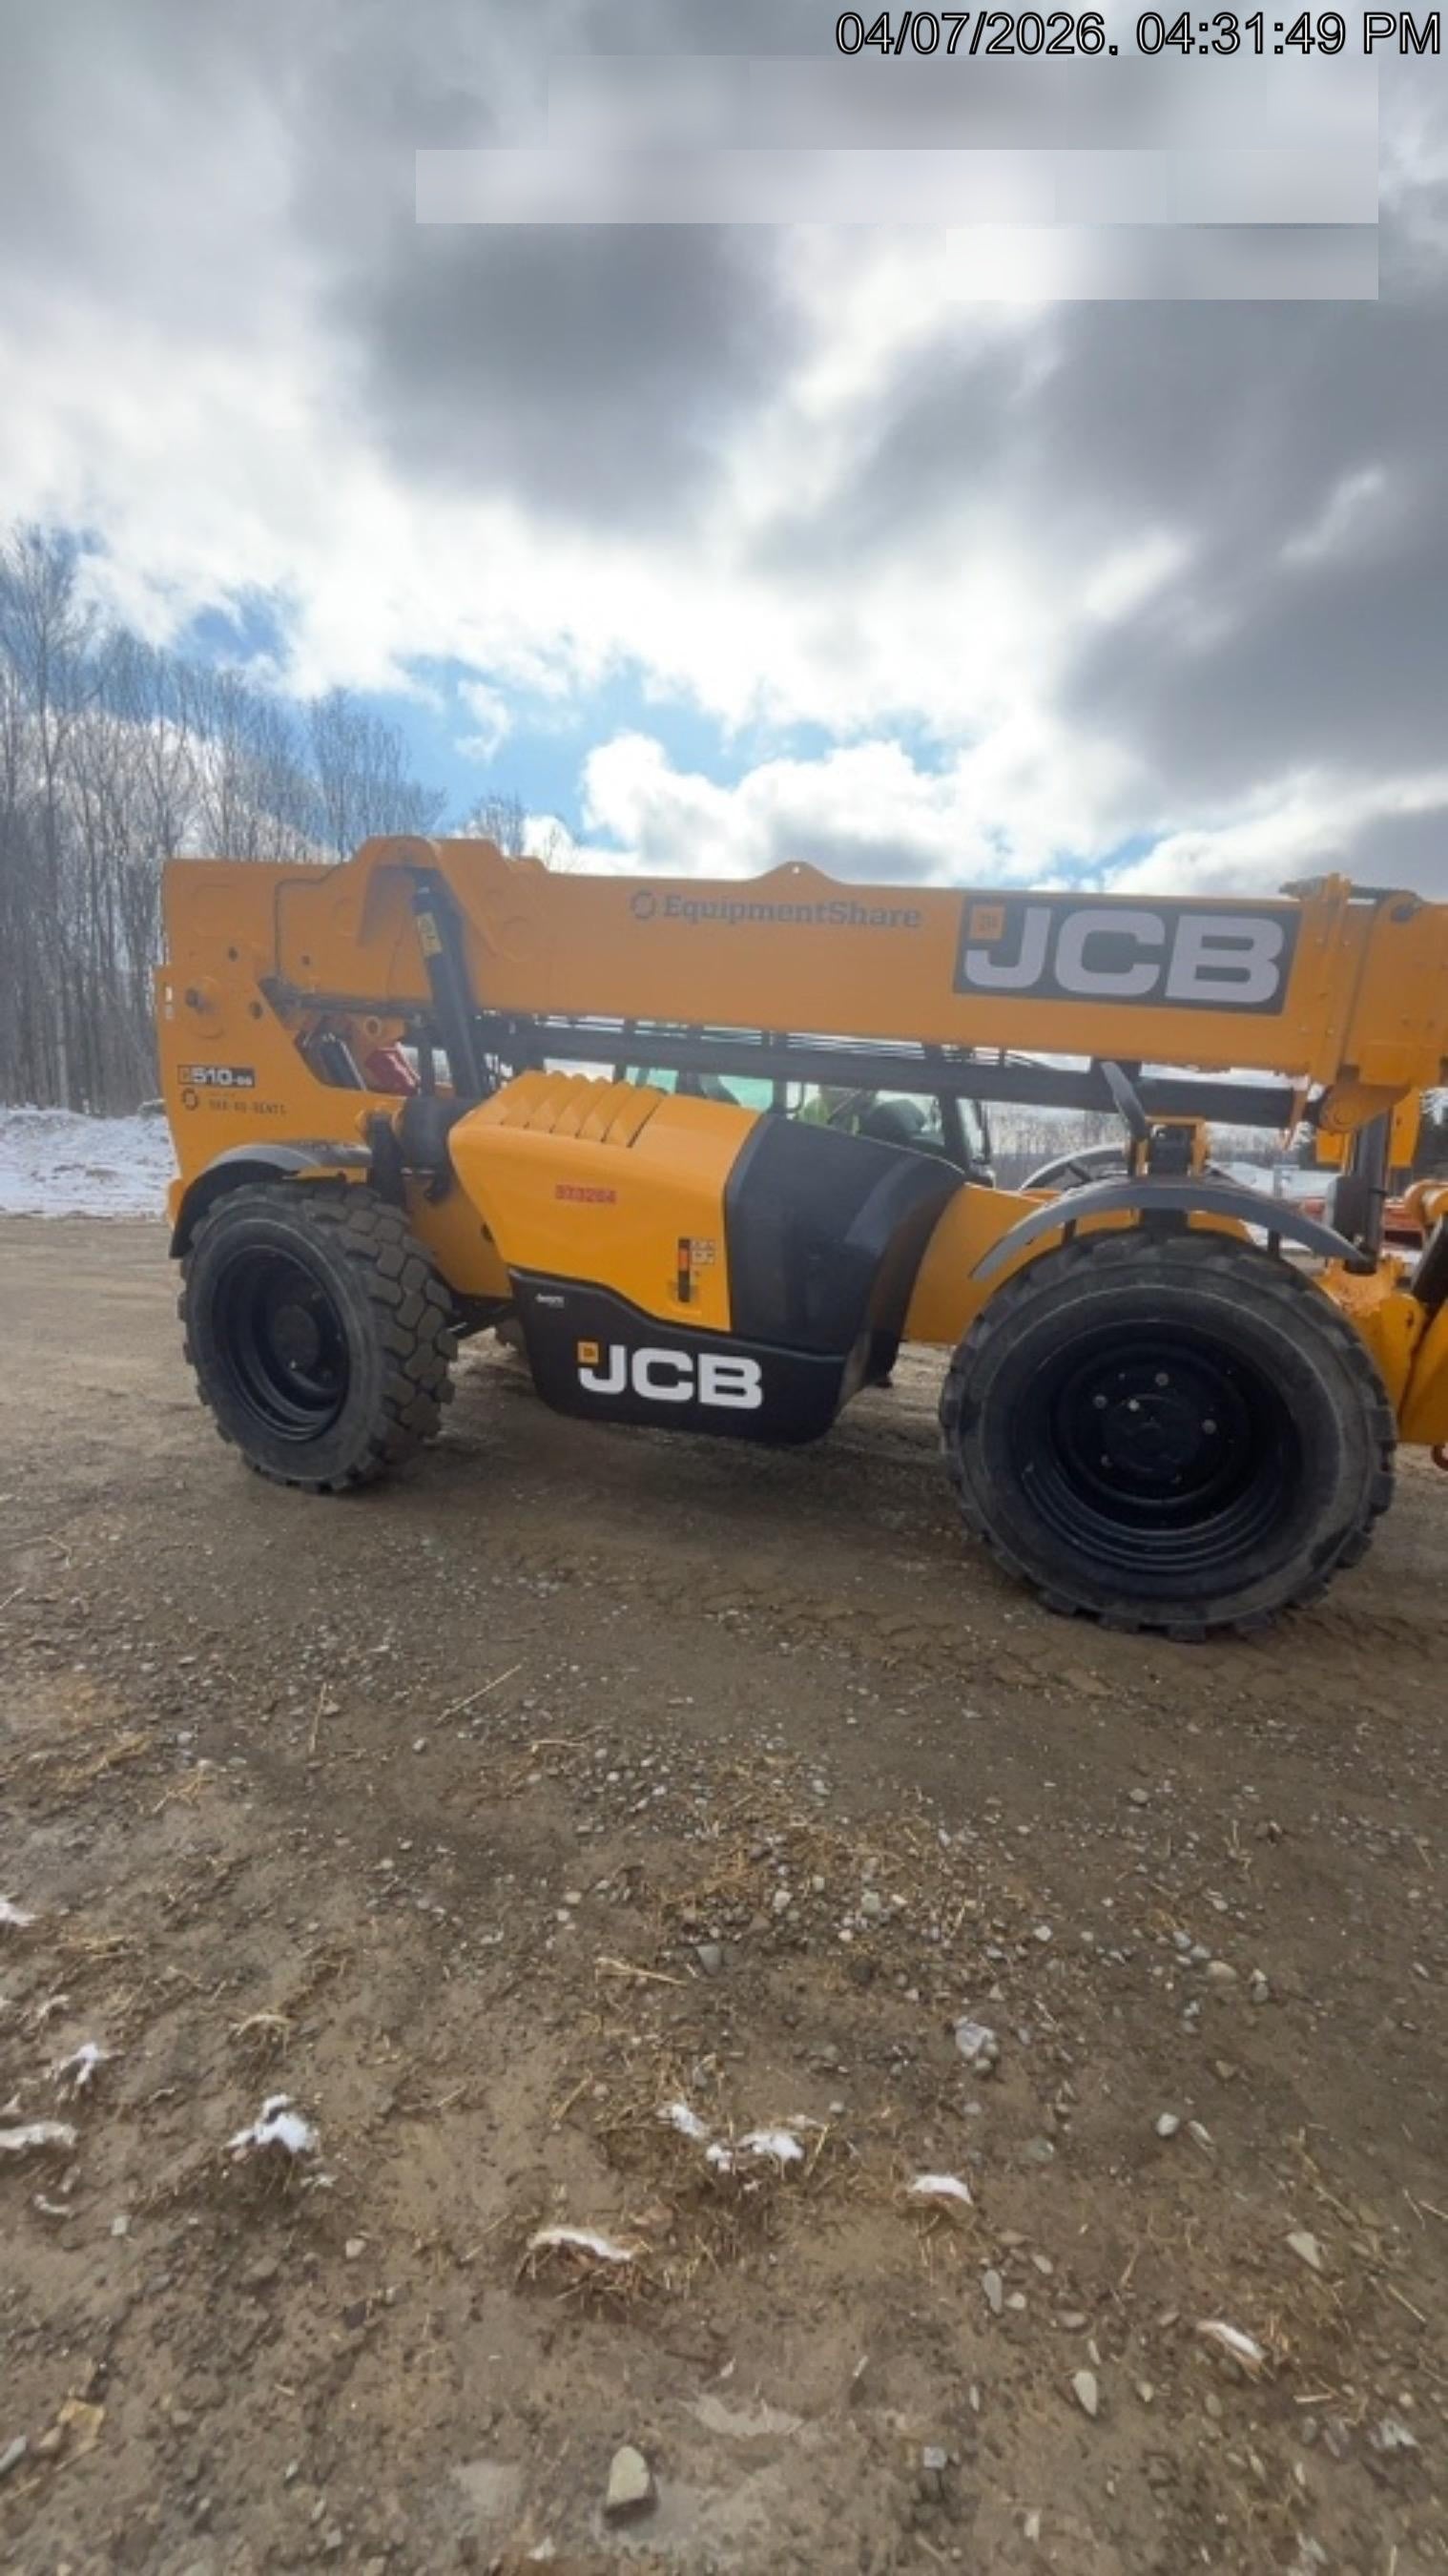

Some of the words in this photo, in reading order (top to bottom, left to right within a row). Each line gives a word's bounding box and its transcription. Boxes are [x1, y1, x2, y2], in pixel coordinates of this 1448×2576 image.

[663, 893, 922, 927] EquipmentShare
[964, 906, 1285, 1003] JCB
[578, 1343, 763, 1410] JCB
